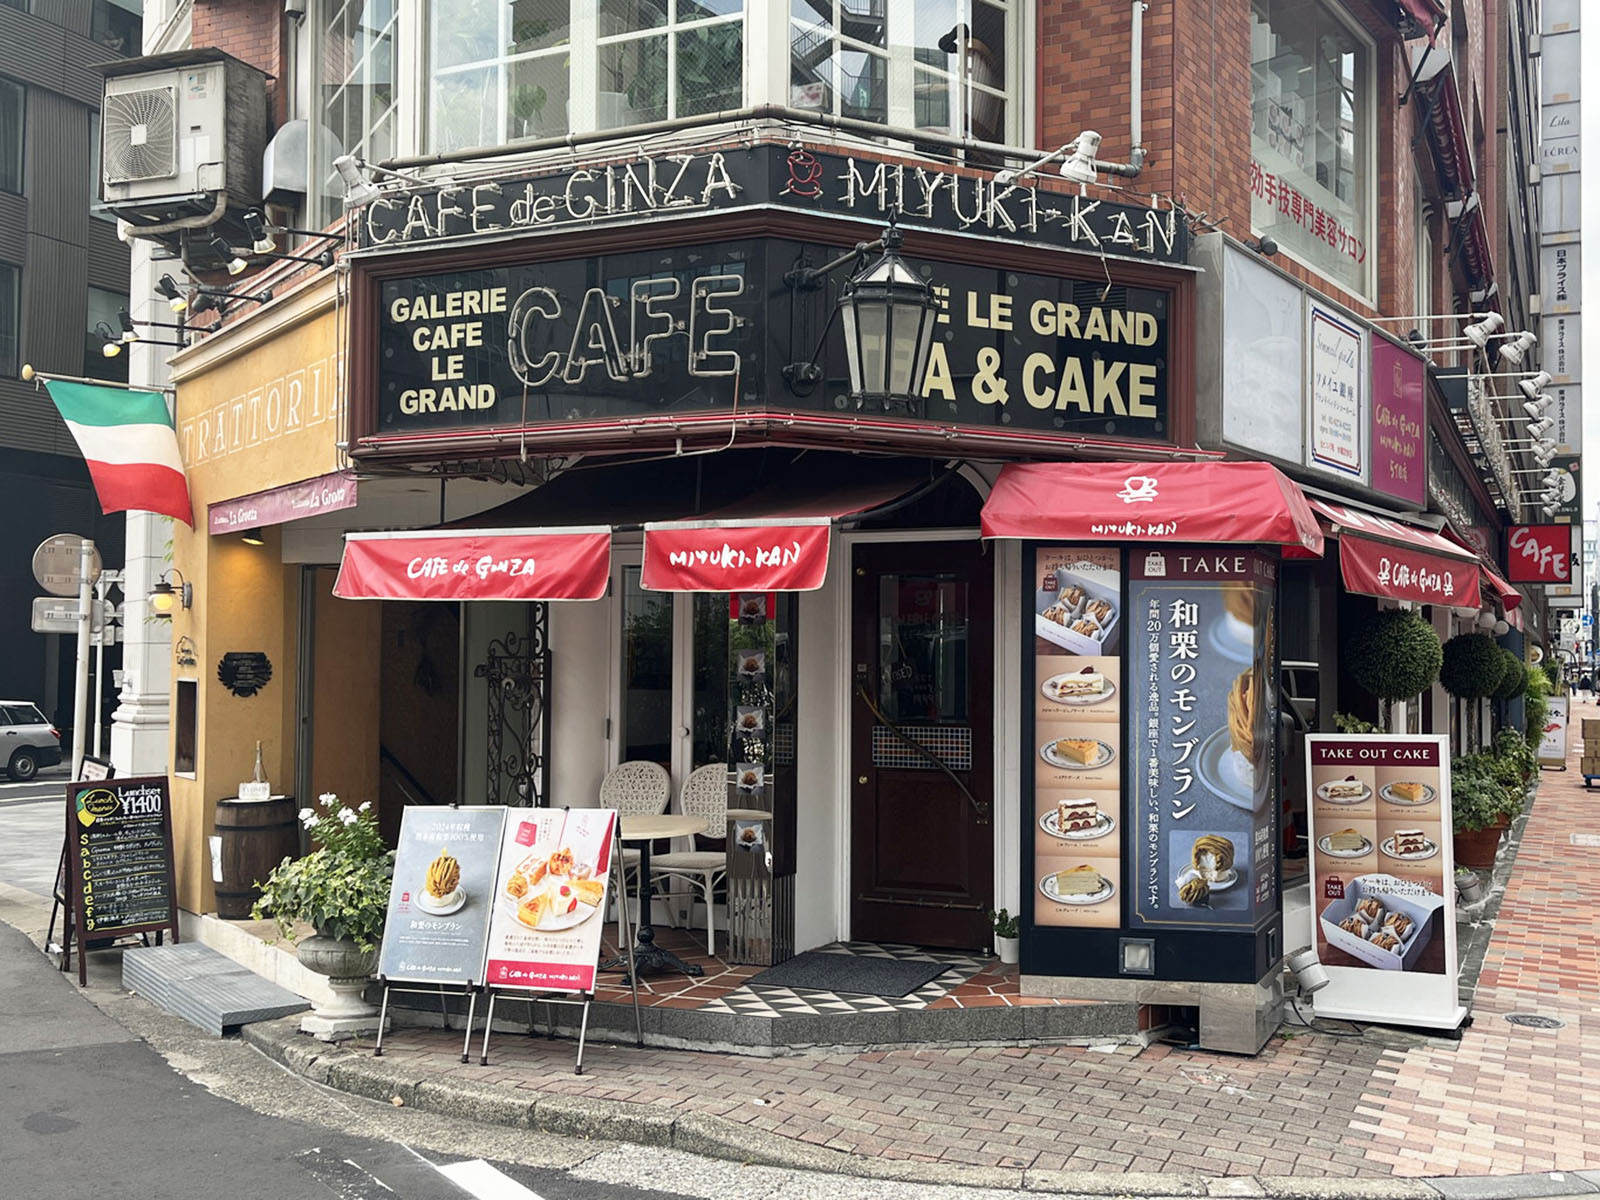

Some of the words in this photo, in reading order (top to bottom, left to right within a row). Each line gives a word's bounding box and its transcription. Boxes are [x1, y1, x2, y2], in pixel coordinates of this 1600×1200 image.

[366, 183, 502, 243] CAFE
[510, 183, 556, 224] de
[565, 152, 741, 219] GINZA
[845, 157, 1177, 255] MIYUKI-KAN
[390, 287, 508, 323] GALERIE
[967, 290, 1014, 331] LE
[1029, 299, 1159, 347] GRAND
[412, 321, 483, 352] CAFE
[507, 274, 744, 388] CAFE
[430, 354, 465, 382] LE
[970, 346, 1010, 406] &
[1021, 351, 1158, 419] CAKE
[399, 384, 497, 415] GRAND
[407, 556, 448, 580] CAFE
[452, 561, 469, 577] de
[475, 554, 536, 580] GINZA
[1178, 556, 1247, 573] TAKE
[1509, 527, 1568, 580] CAFE
[1167, 598, 1200, 821] 和栗のモンブラン
[1320, 748, 1354, 759] TAKE
[1359, 748, 1388, 760] OUT
[1393, 749, 1431, 760] CAKE
